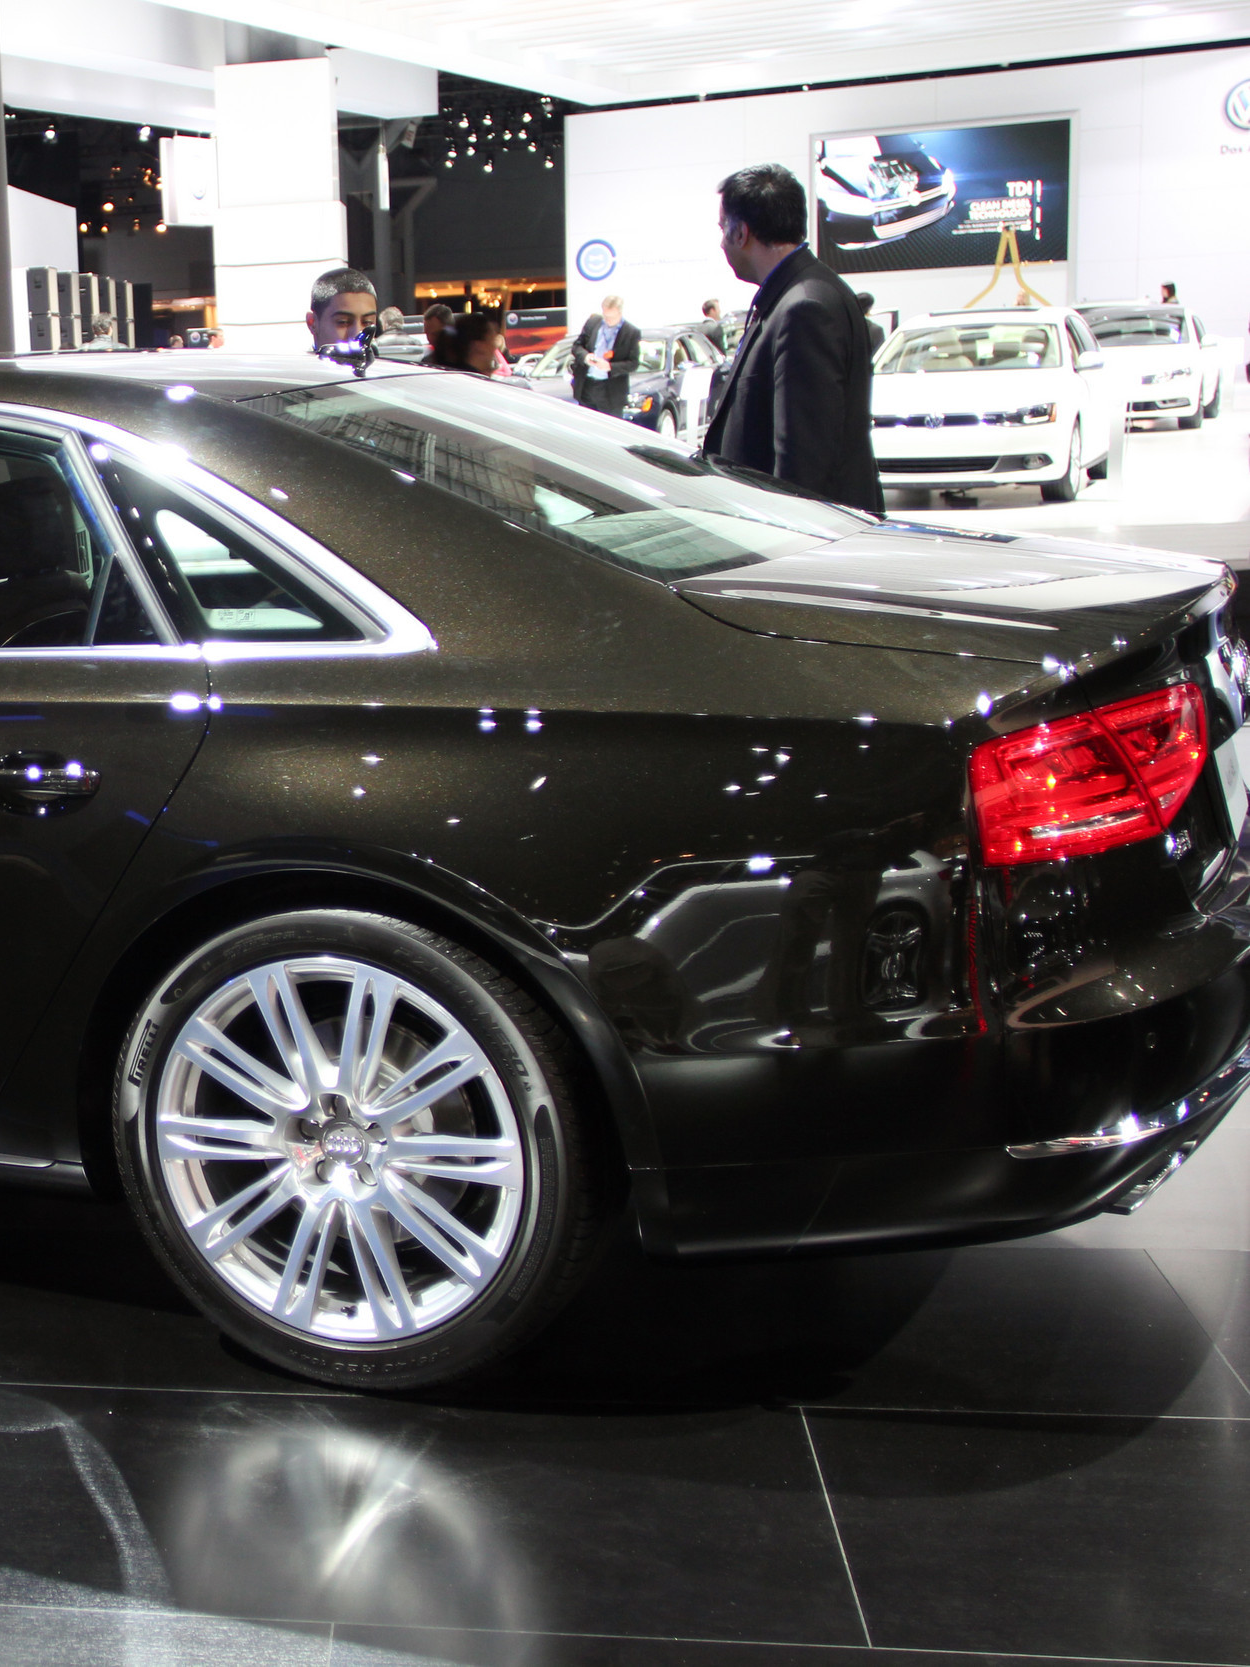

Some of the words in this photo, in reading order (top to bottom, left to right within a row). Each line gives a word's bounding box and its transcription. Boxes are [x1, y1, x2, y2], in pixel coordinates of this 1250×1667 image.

[1006, 180, 1033, 197] TDI
[970, 201, 1000, 212] CLEAN
[1002, 198, 1032, 209] DIESEL
[969, 208, 1032, 220] TECHNOLOGY
[128, 1019, 160, 1088] PIRELLI
